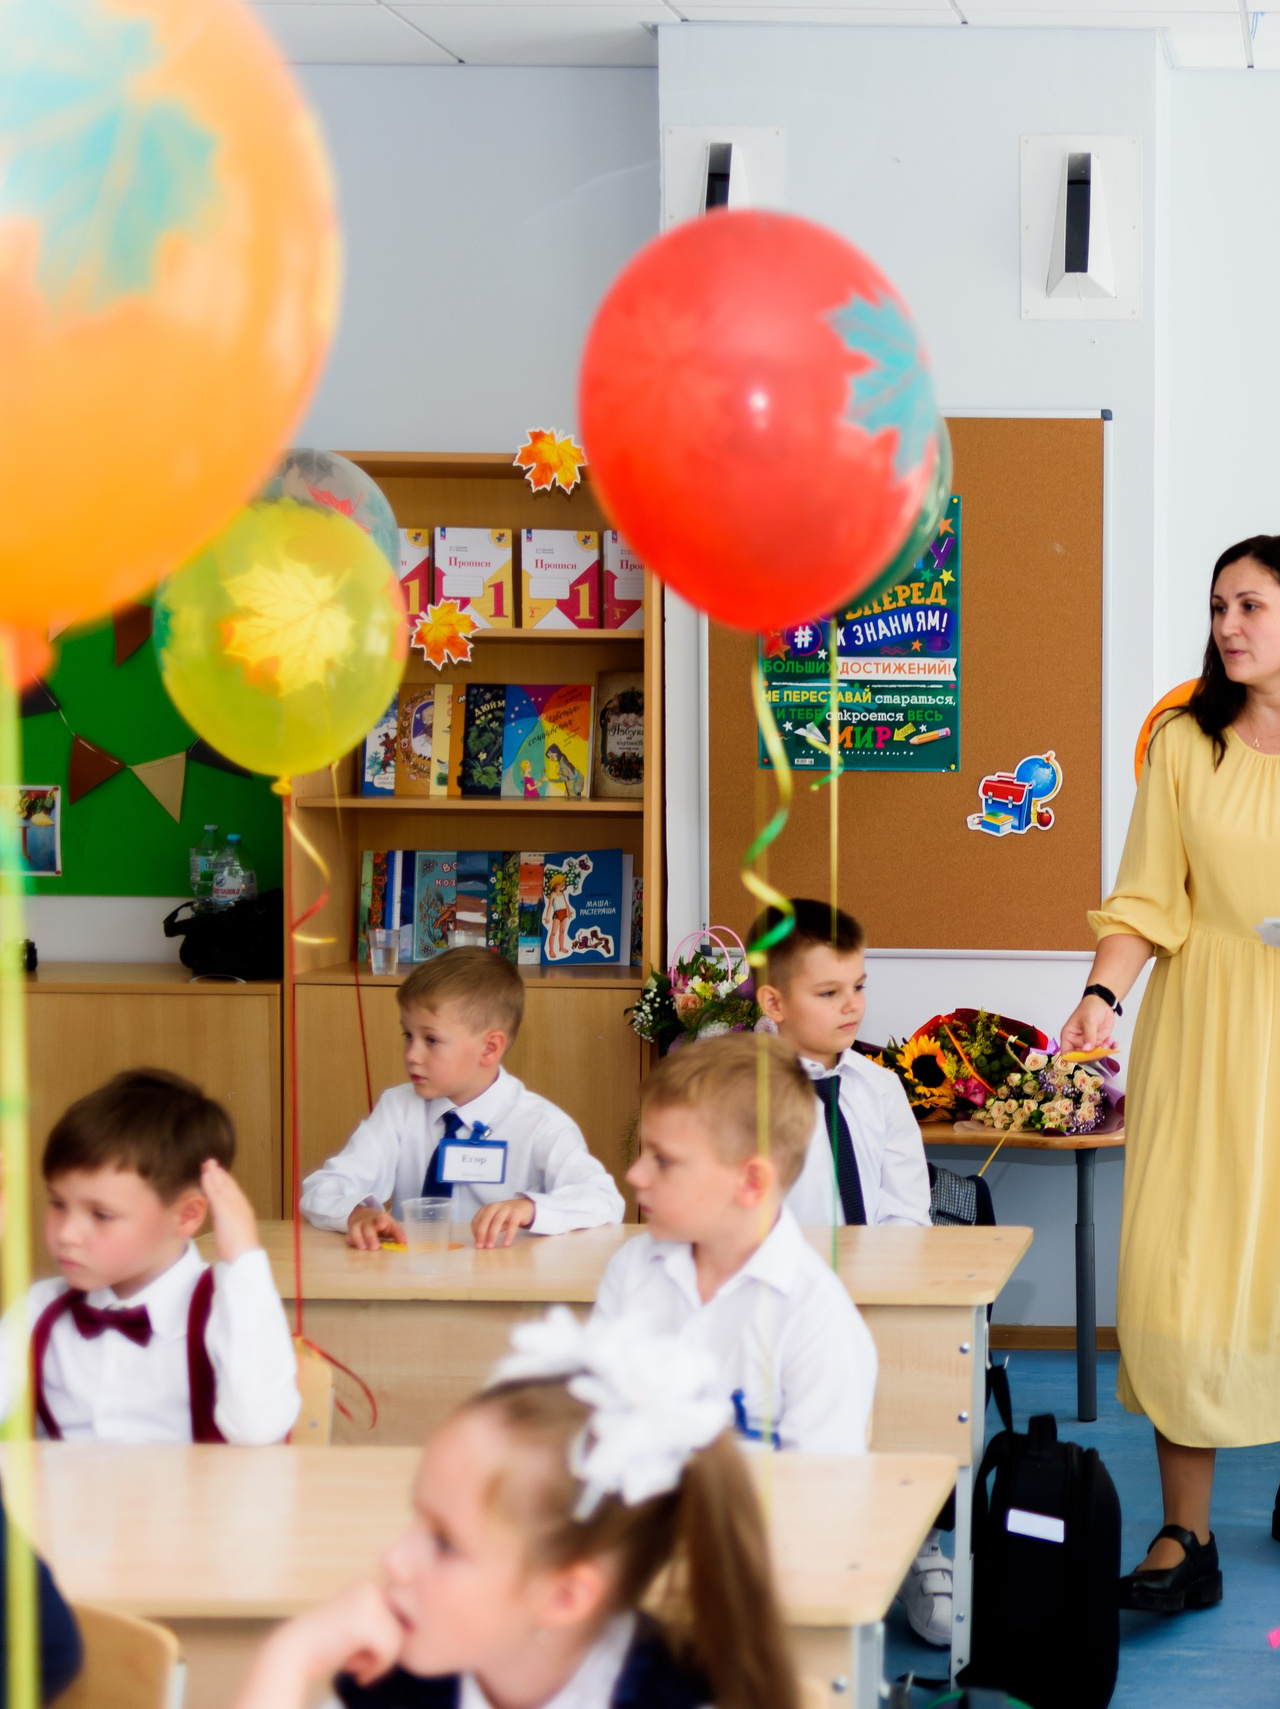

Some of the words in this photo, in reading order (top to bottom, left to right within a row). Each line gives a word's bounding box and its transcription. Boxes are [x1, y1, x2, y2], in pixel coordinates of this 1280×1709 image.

[448, 556, 491, 568] Прописи
[534, 558, 577, 570] Прописи
[488, 580, 509, 618] 1
[573, 582, 594, 619] 1
[852, 610, 948, 646] ЗНАНИЯМ!
[839, 659, 951, 676] ДОСТИЖЕНИЙ!
[875, 693, 956, 706] стараться,
[776, 708, 785, 720] И
[789, 708, 822, 720] ТЕБЕ
[907, 710, 943, 722] ВЕСЬ
[827, 725, 892, 749] МИР
[580, 906, 617, 916] РАСТЕРЯША
